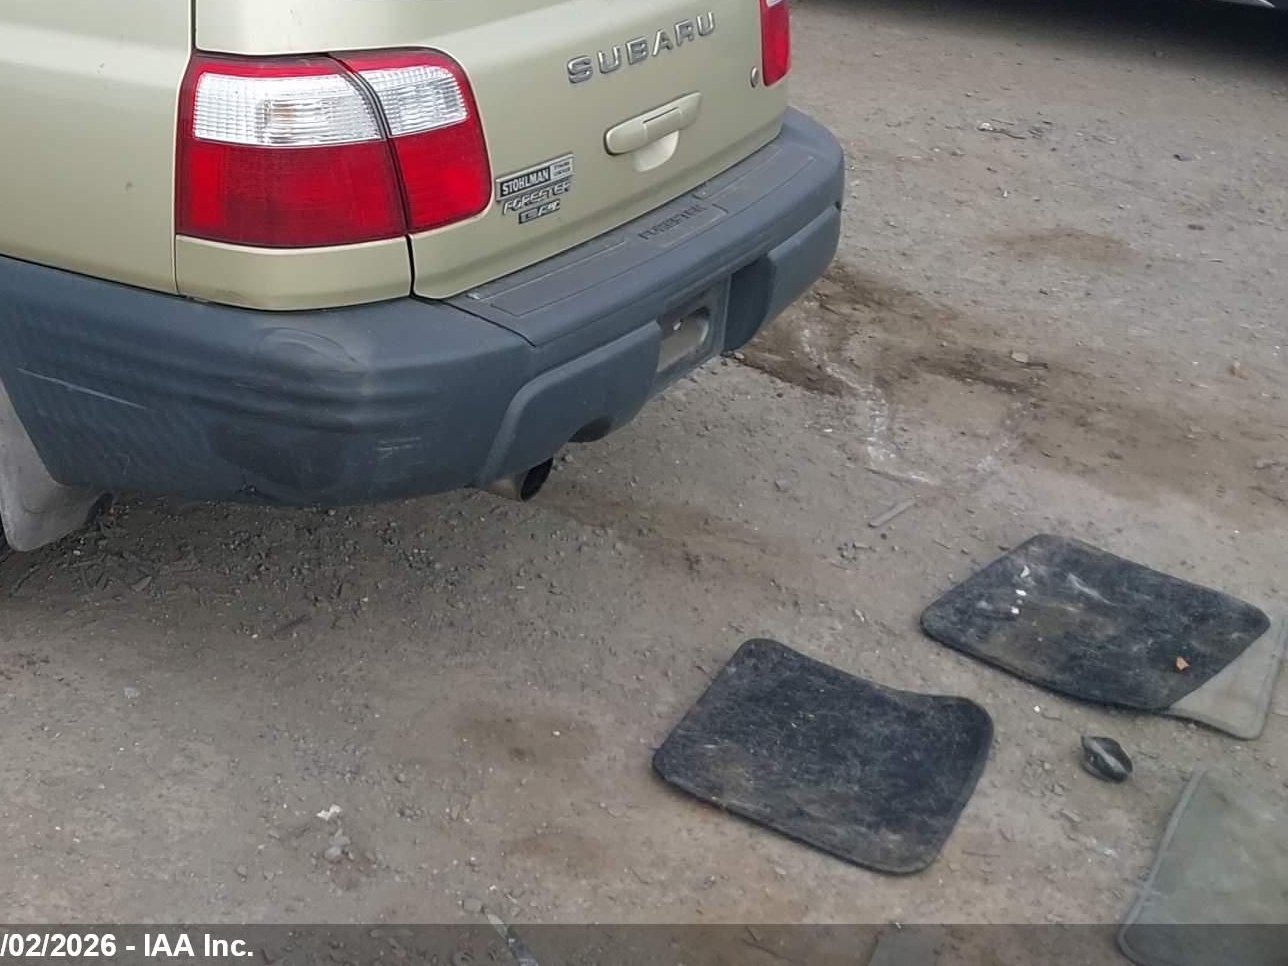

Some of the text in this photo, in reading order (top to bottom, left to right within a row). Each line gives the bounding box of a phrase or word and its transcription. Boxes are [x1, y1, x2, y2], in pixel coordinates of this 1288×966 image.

[567, 11, 715, 84] SUBARU
[502, 168, 549, 195] STOHLMAN
[503, 181, 570, 215] FORESTER
